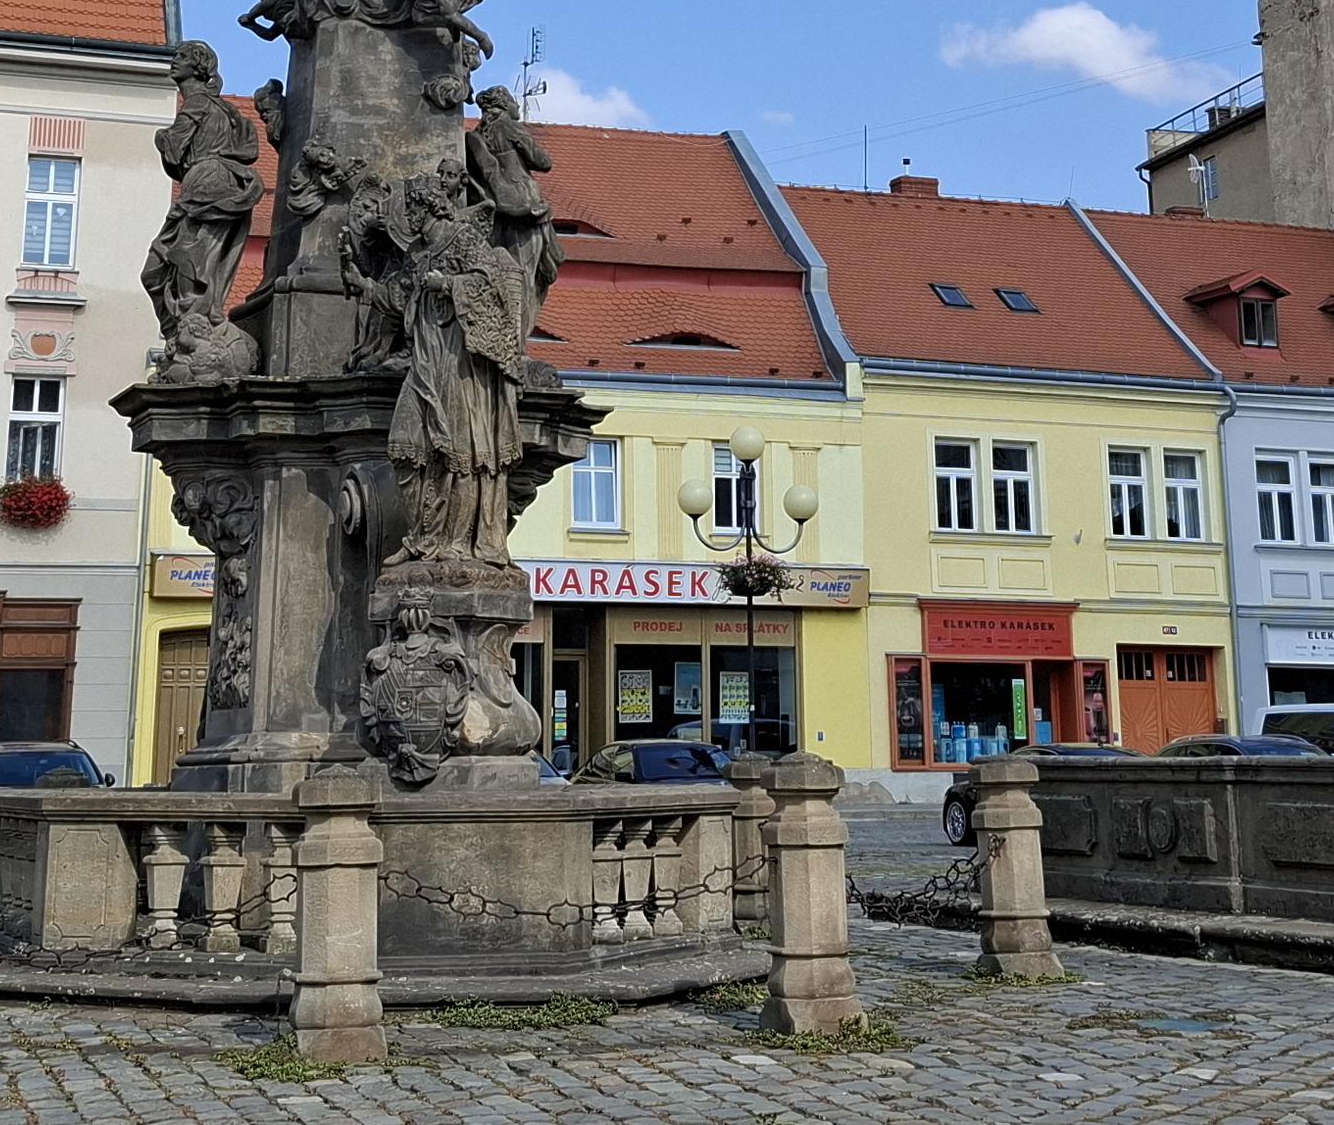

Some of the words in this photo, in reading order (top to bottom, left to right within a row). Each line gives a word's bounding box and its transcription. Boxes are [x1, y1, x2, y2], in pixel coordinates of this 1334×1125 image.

[534, 564, 710, 598] KARÁSEK
[810, 581, 852, 592] PLANEO
[633, 621, 683, 632] PRODEJ
[714, 622, 732, 633] NA
[943, 619, 995, 629] ELEKTRO
[1000, 619, 1056, 631] KARÁSEK
